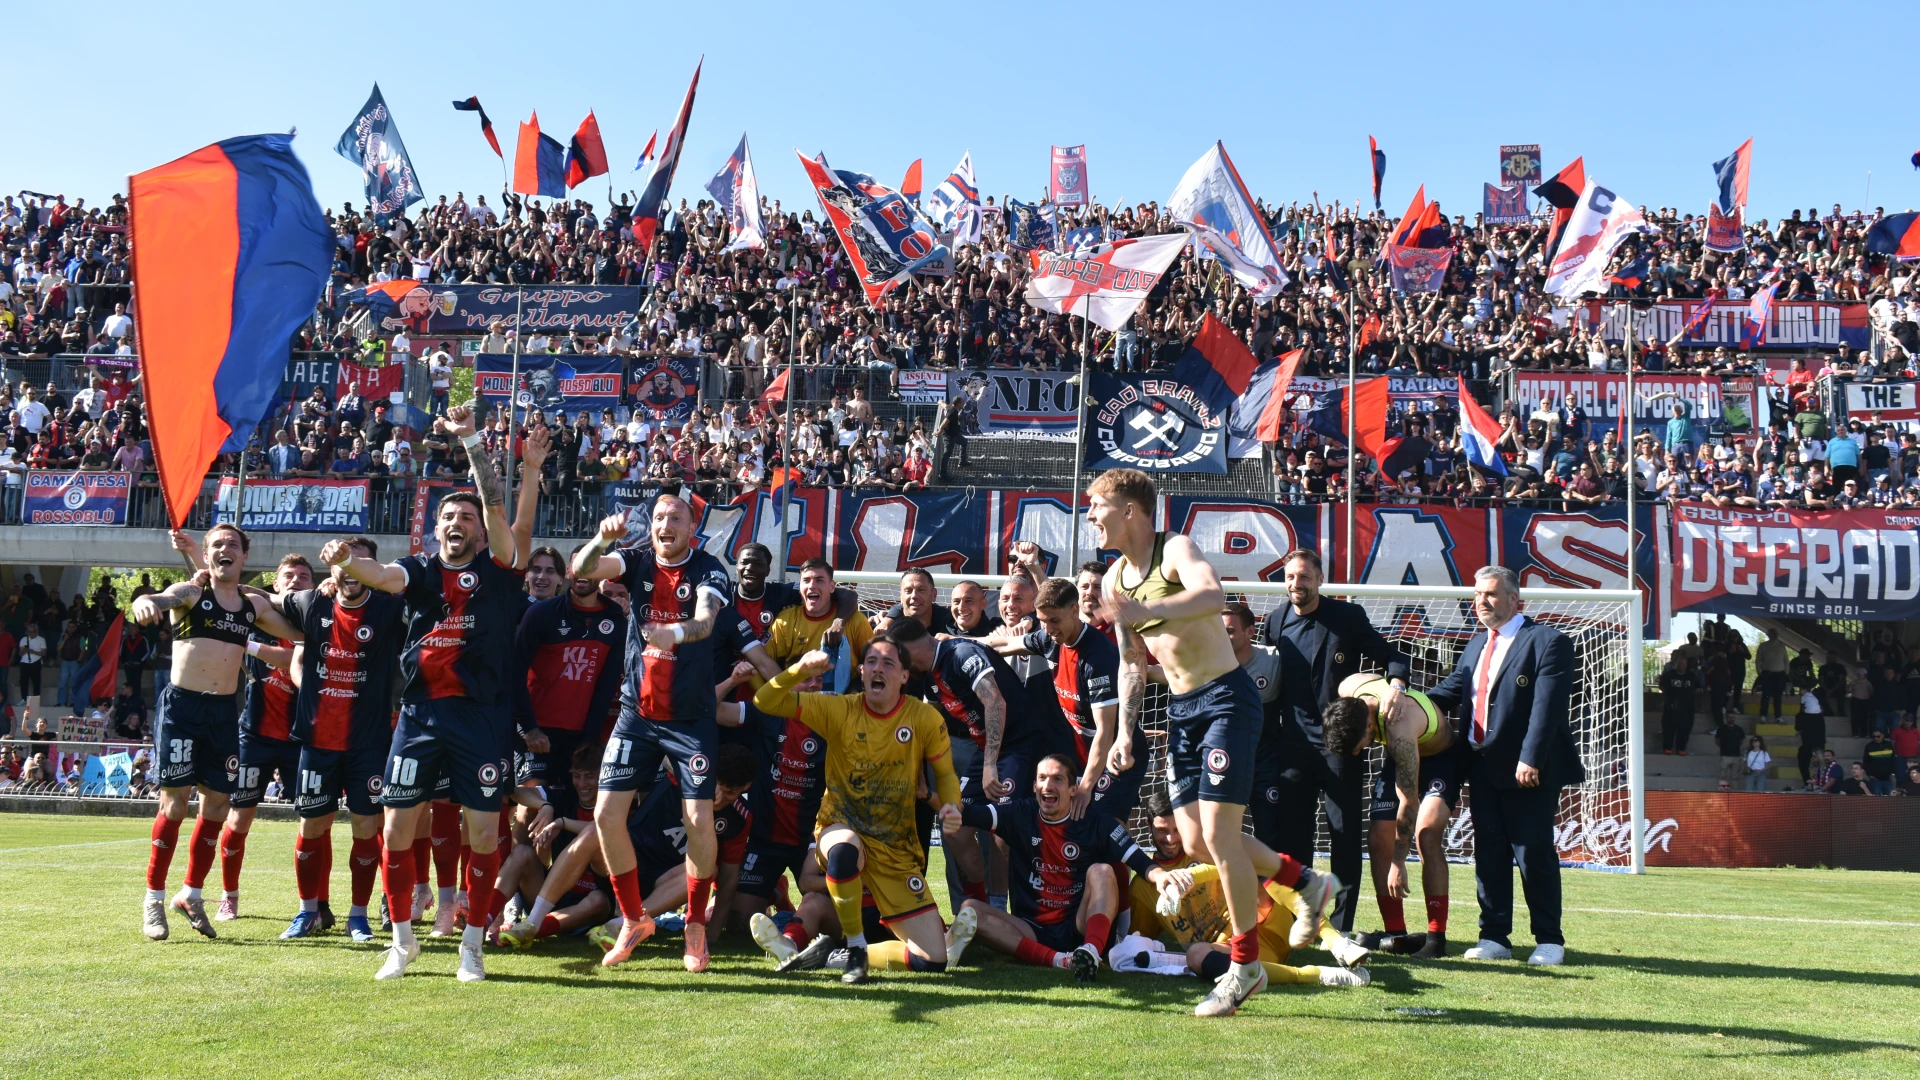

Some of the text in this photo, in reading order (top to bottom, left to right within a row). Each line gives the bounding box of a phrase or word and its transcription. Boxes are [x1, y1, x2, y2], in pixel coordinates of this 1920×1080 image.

[1488, 199, 1527, 217] TALK
[1485, 215, 1529, 224] CAMPOBASSO
[477, 287, 612, 308] Gruppo
[1765, 304, 1841, 344] LUGLIO
[905, 372, 942, 380] ASSENTI
[1721, 381, 1754, 391] SIMILIANO
[1097, 384, 1139, 426] BAD
[1519, 379, 1720, 419] PAZZI DEL CAMPOBASSO
[1861, 385, 1902, 409] THE
[1097, 427, 1220, 469] CAMPOBASSO
[30, 473, 127, 488] GAMBATESA
[321, 486, 365, 513] DEN
[614, 487, 659, 498] RALL' MO'
[32, 507, 115, 524] ROSSOBLÙ
[215, 512, 362, 528] GUARDIALFIERA
[1680, 506, 1920, 526] GRUPPO CAMPO
[1677, 520, 1920, 601] DEGRAD
[225, 613, 234, 622] 32
[443, 614, 476, 623] IVERSO
[1769, 603, 1859, 616] SINCE 2021
[204, 617, 250, 636] K-SPORT
[562, 619, 567, 627] 5
[562, 646, 590, 664] KL
[559, 662, 589, 682] AY
[586, 648, 600, 683] MEDIA
[330, 675, 367, 683] CERAMICHE
[169, 738, 194, 764] 32
[603, 737, 633, 765] 31
[238, 766, 260, 789] 18
[390, 755, 419, 786] 10
[301, 769, 322, 795] 14
